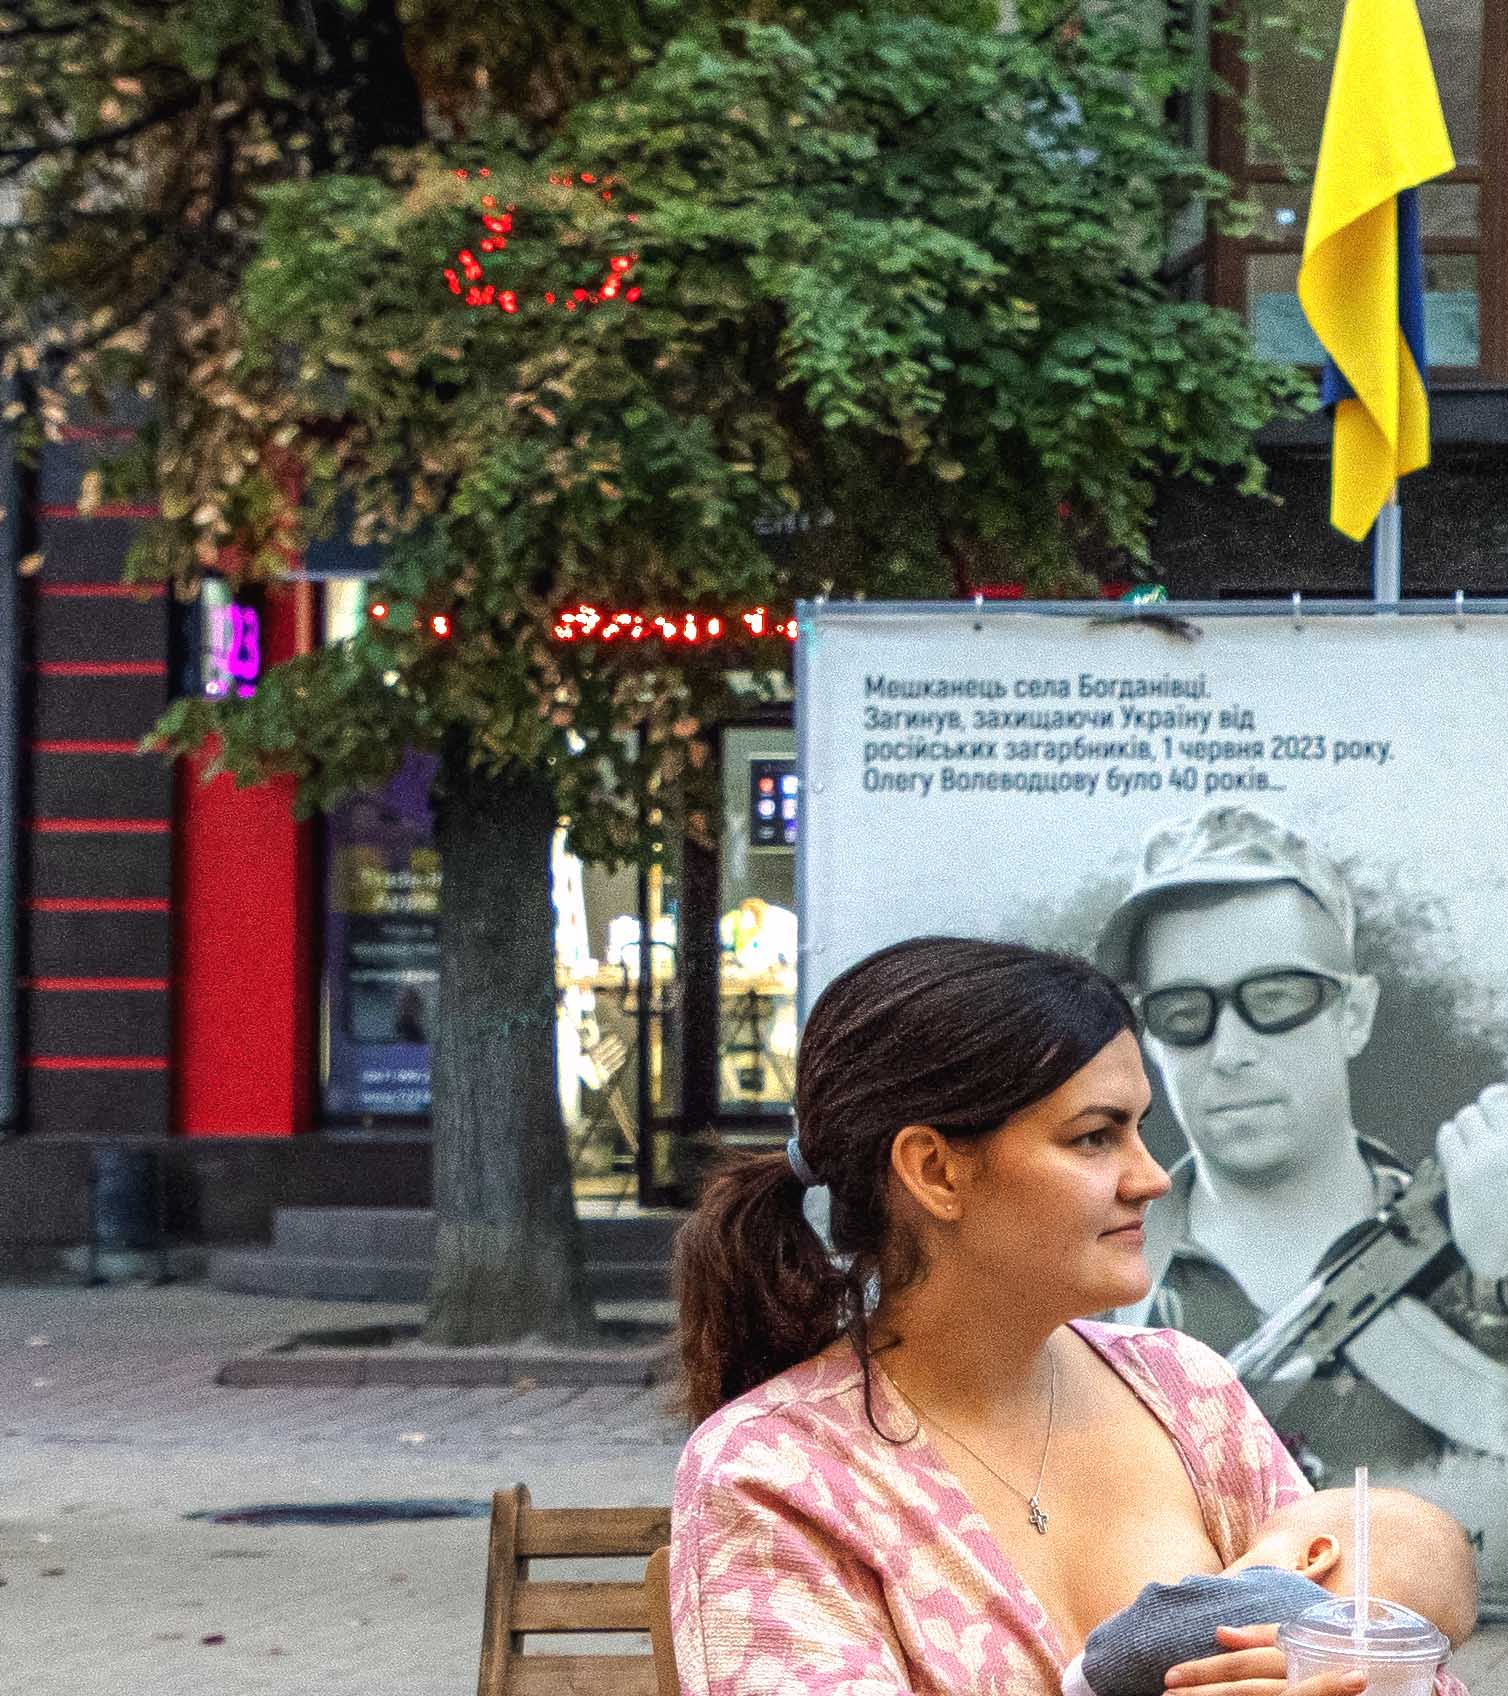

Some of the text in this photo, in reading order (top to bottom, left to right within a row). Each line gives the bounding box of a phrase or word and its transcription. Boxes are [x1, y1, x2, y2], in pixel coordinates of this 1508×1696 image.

[864, 673, 1211, 700] Мешканець села Богданівці.
[863, 704, 1256, 734] Загинув, захищаючи Україну від
[863, 734, 1394, 765] російських загарбників, 1 червня 2023 року.
[862, 767, 934, 797] Олегу
[1106, 767, 1163, 797] було
[1168, 767, 1199, 791] 40
